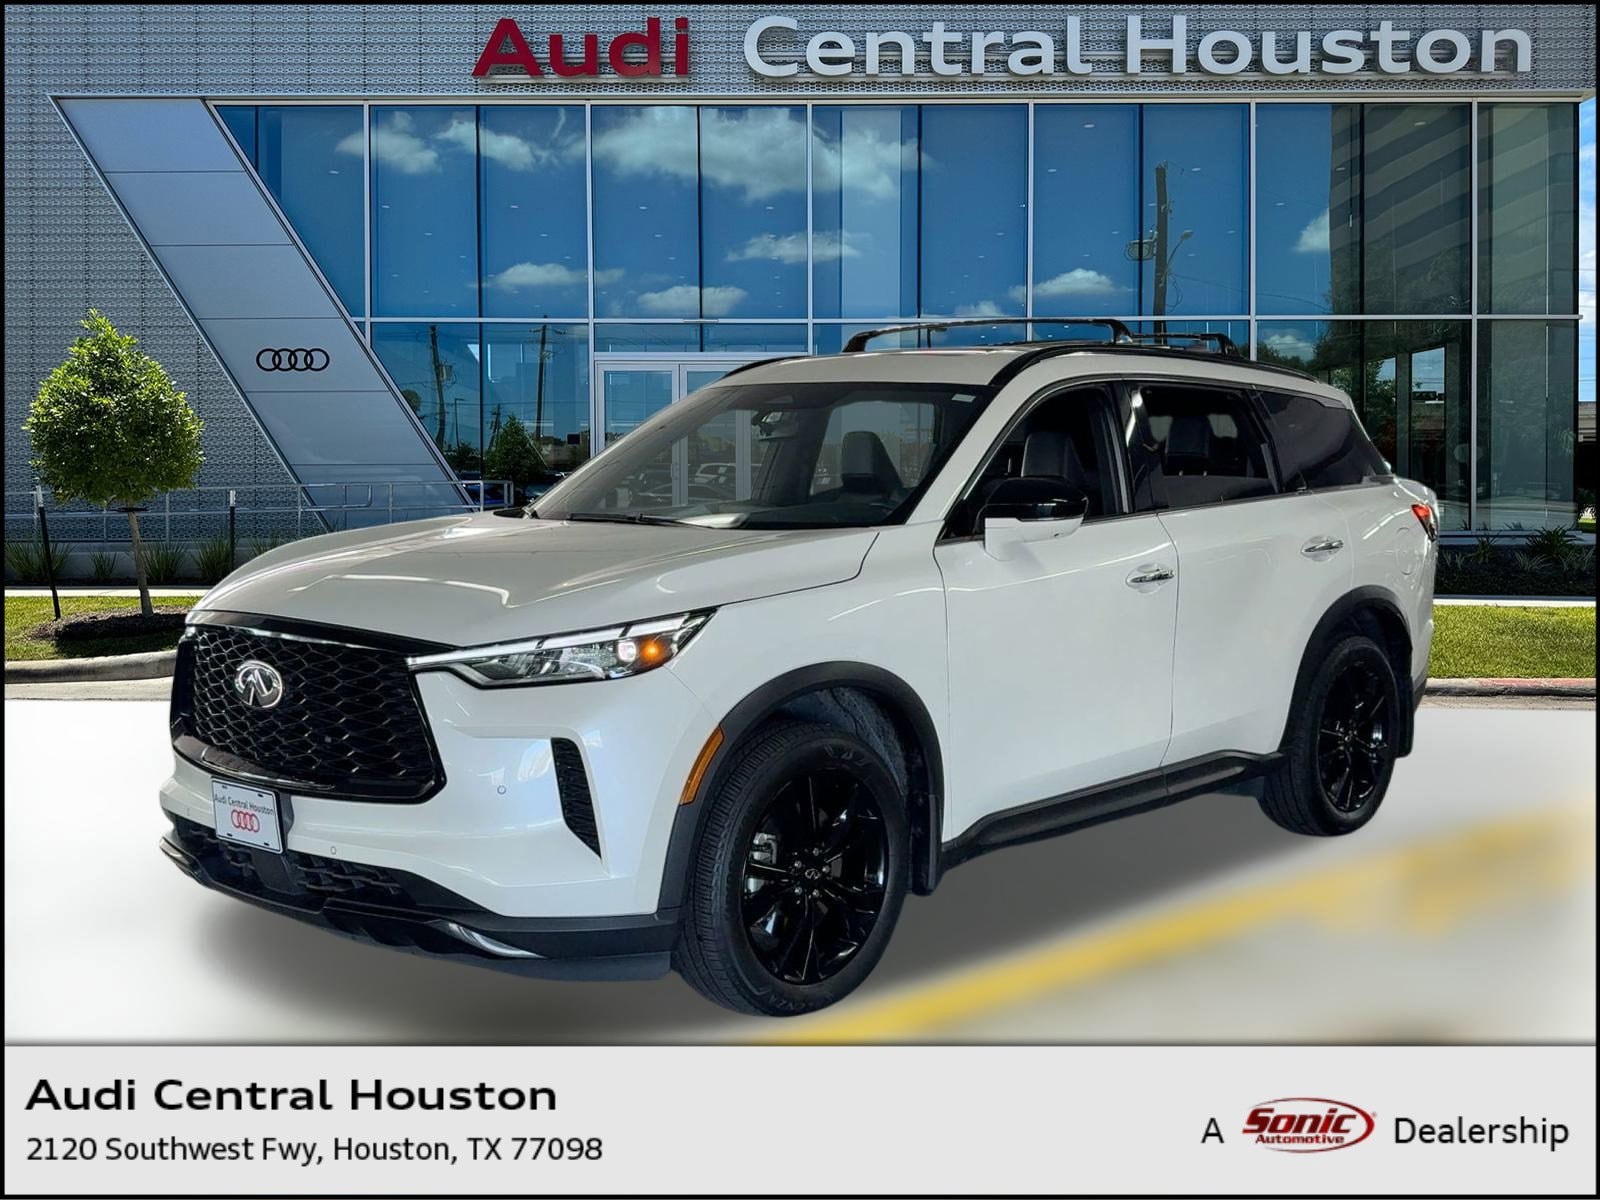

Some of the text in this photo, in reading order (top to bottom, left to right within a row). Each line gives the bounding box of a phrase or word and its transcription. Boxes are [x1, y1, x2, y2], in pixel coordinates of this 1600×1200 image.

[471, 14, 1532, 77] Audi Central Houston
[228, 796, 249, 809] Central
[249, 802, 275, 816] Houston
